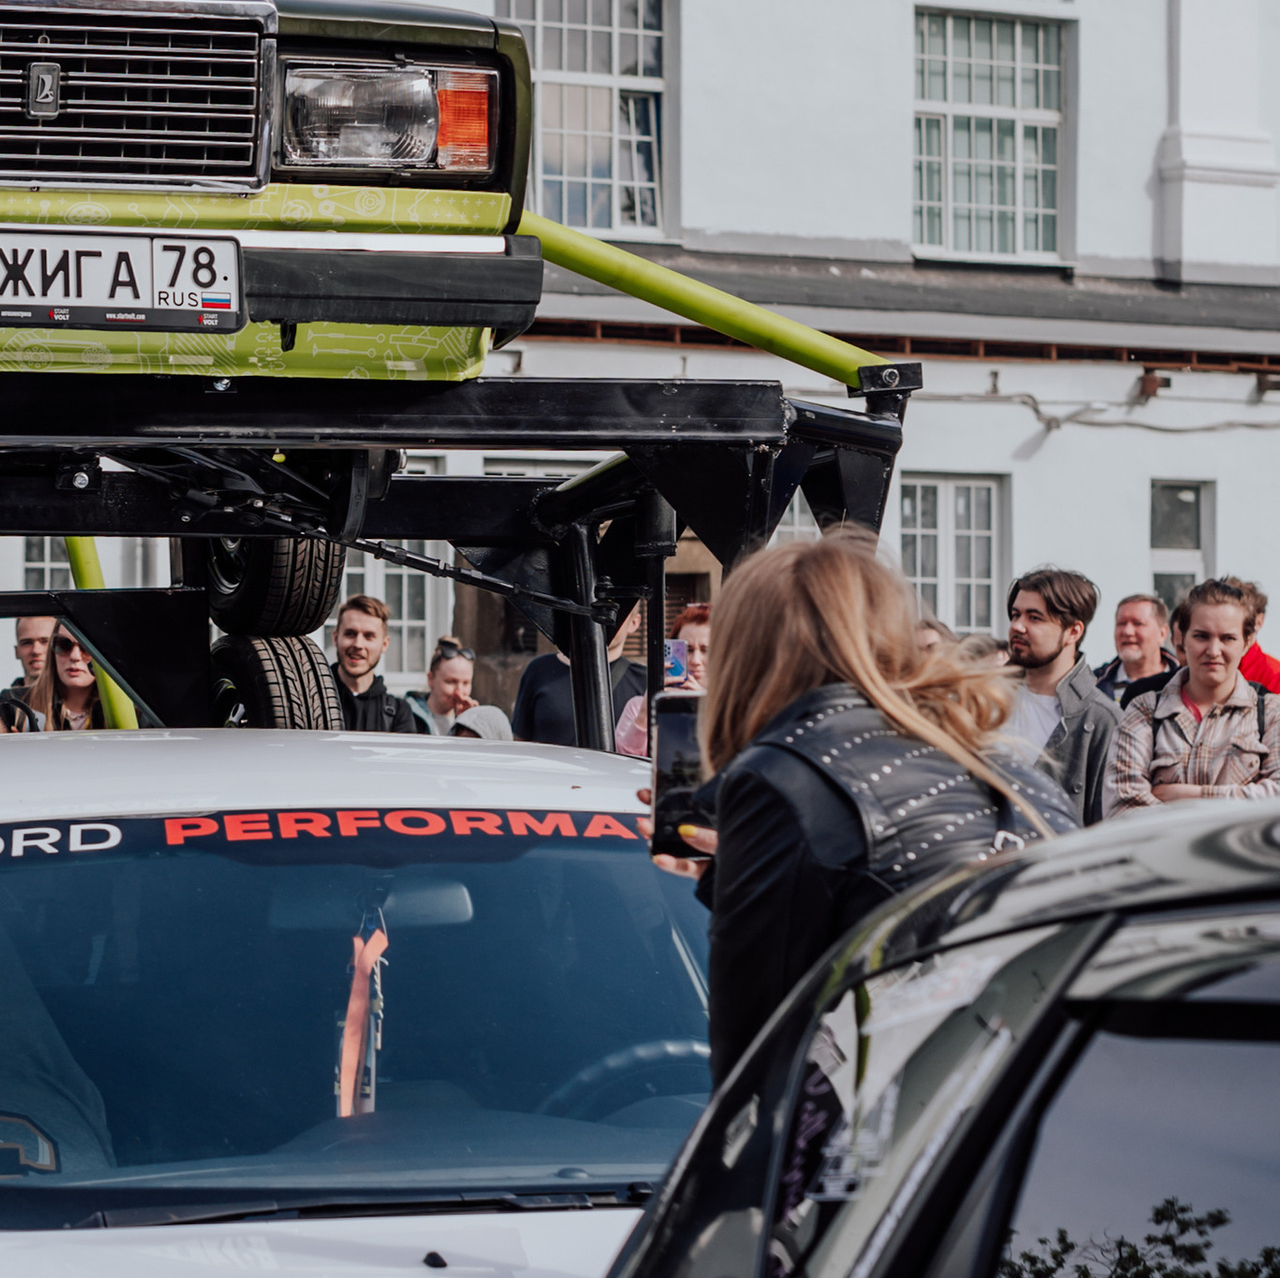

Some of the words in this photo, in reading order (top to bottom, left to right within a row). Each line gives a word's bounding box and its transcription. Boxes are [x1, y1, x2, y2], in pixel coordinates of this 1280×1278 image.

[162, 244, 217, 288] 78
[158, 291, 199, 307] RUS
[164, 809, 642, 846] PERFORMA
